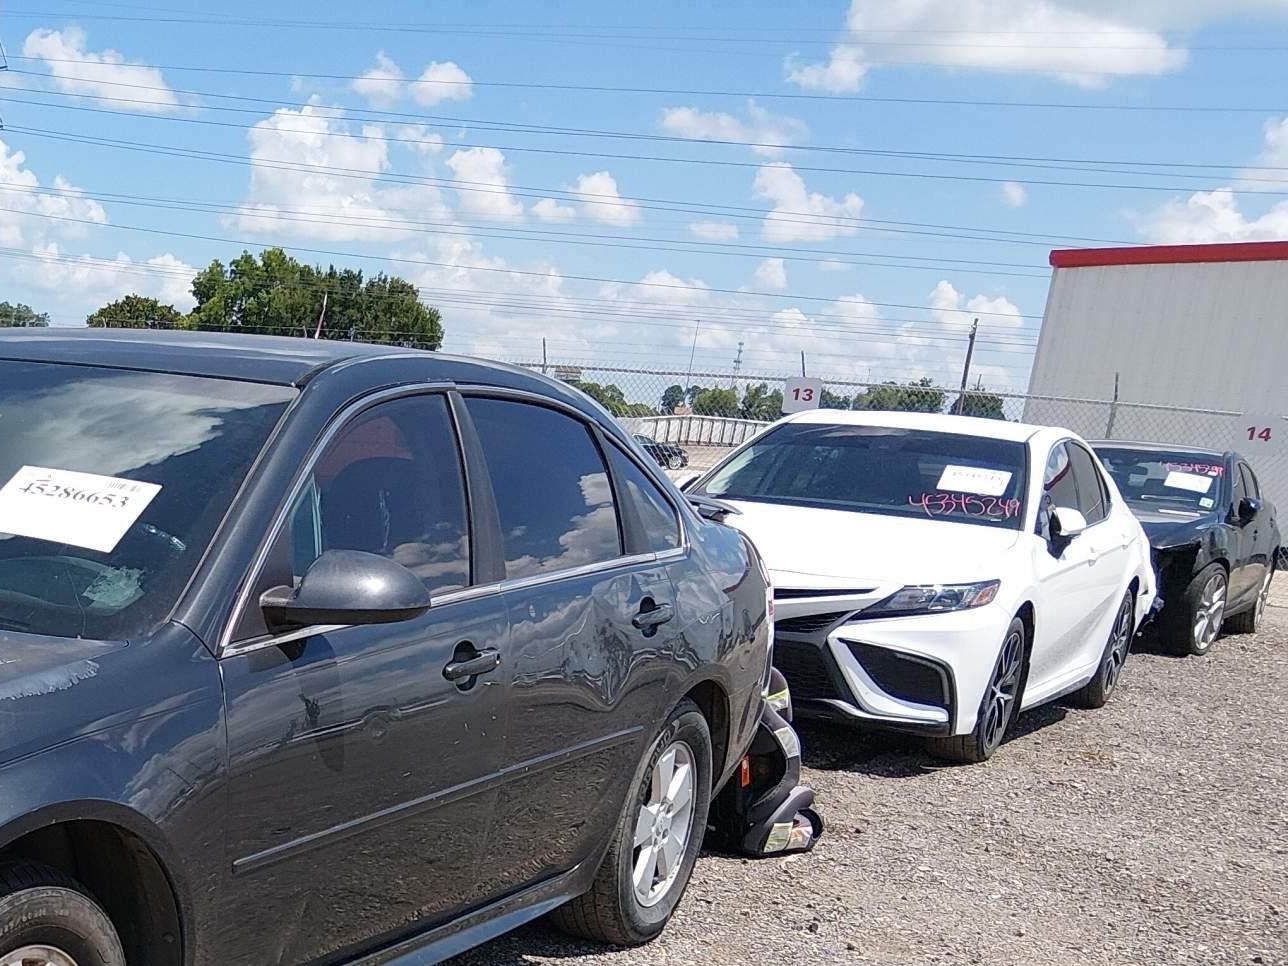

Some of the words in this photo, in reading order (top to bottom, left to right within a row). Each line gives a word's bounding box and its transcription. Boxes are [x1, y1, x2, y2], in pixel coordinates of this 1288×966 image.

[792, 387, 814, 402] 13
[1247, 426, 1272, 442] 14
[18, 482, 129, 508] 45286653
[908, 493, 1021, 518] 45345249
